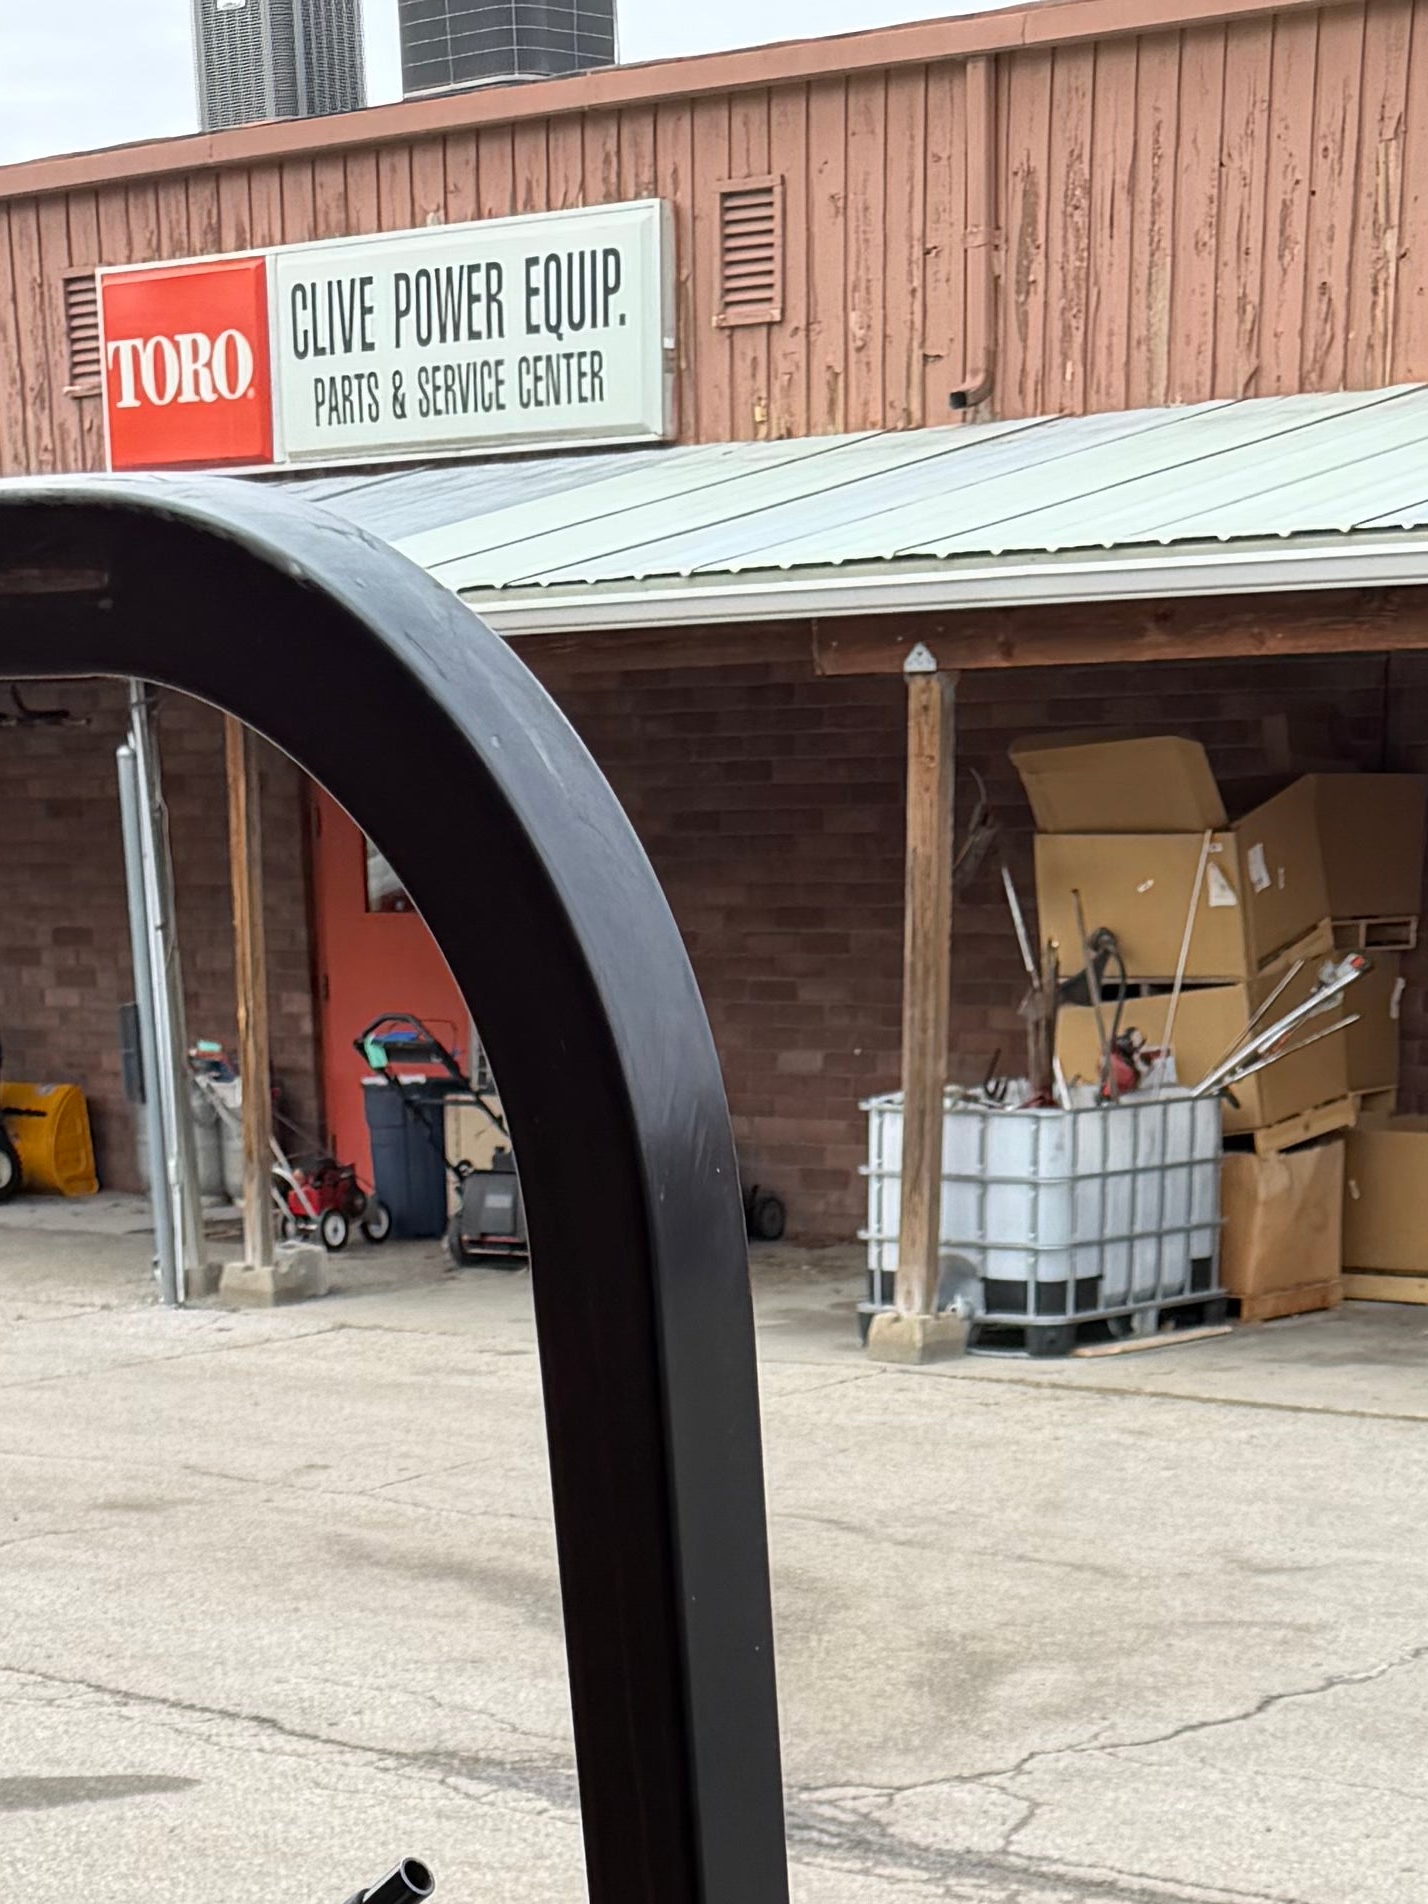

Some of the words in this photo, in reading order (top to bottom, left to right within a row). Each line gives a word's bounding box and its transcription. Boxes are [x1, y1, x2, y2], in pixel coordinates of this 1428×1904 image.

[289, 275, 375, 360] CLIVE
[394, 261, 504, 348] POWER
[525, 247, 627, 341] EQUIP.
[107, 329, 254, 409] TORO
[314, 371, 380, 428] PARTS
[392, 370, 408, 421] &
[418, 358, 507, 418] SERVICE
[518, 350, 605, 409] CENTER
